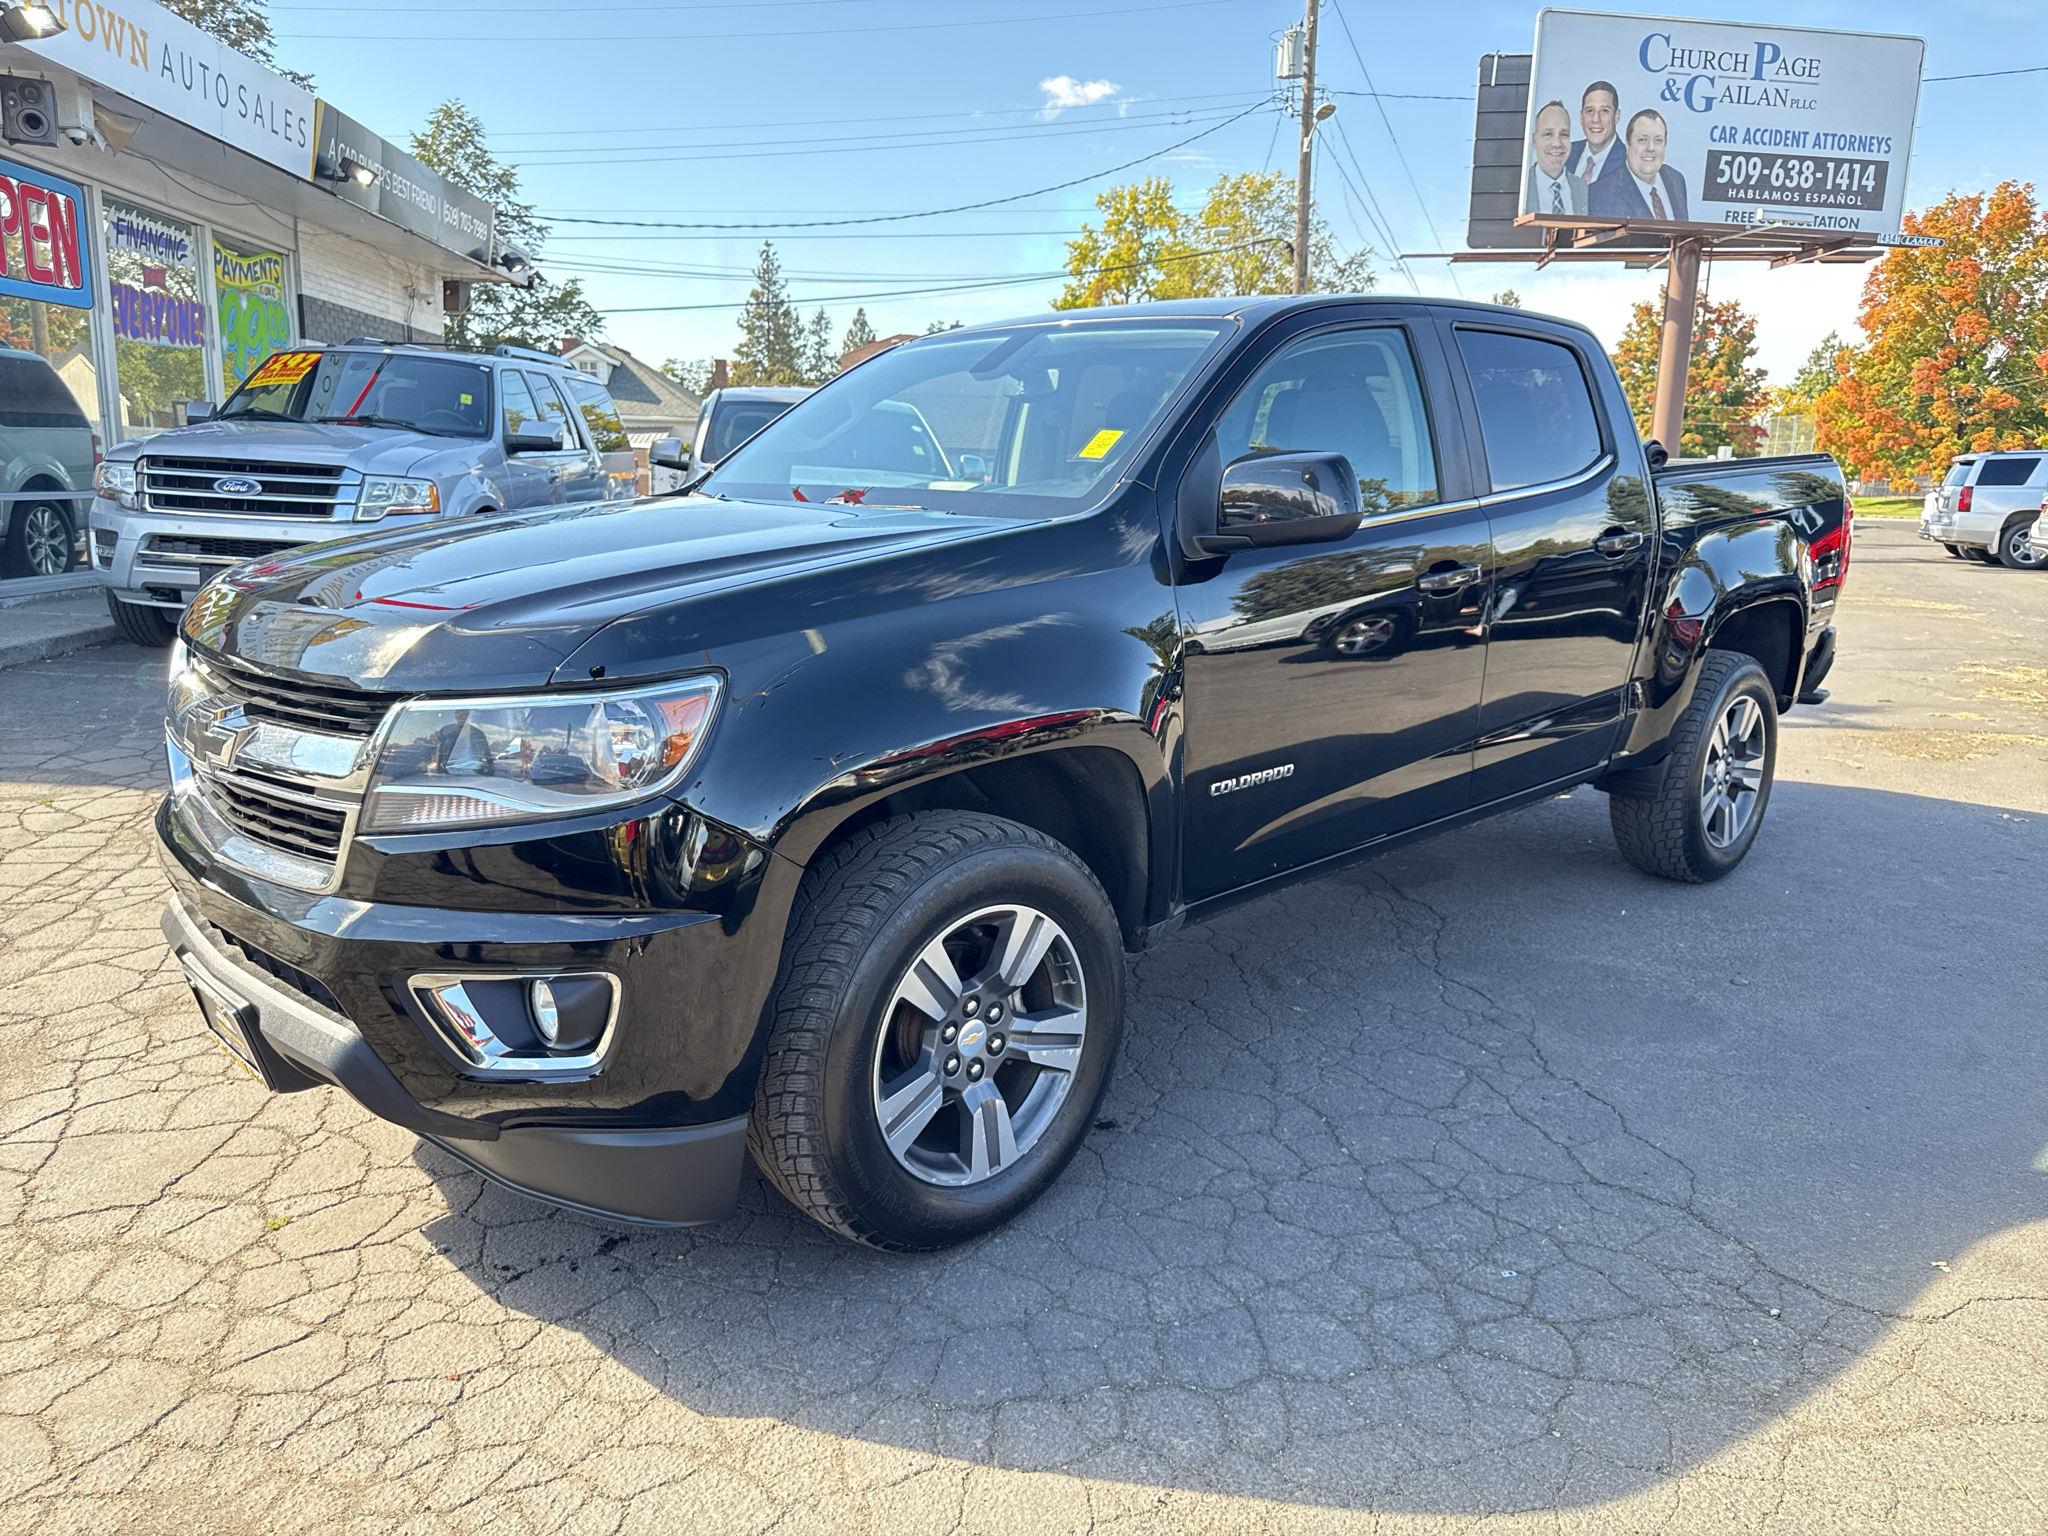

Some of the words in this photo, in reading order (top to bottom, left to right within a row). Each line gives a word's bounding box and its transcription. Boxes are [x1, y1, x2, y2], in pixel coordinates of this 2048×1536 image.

[1638, 32, 1750, 73] CHURCH
[1750, 41, 1821, 82] PAGE
[160, 43, 229, 109] AUTO
[238, 84, 306, 149] SALES
[1684, 74, 1790, 113] GAILAN
[1790, 98, 1817, 110] PLLC
[1709, 125, 1738, 145] CAR
[1742, 127, 1809, 149] ACCIDENT
[1812, 132, 1892, 154] ATTORNEYS
[328, 137, 336, 162] A
[392, 173, 412, 201] BEST
[411, 184, 436, 215] FRIEND
[1716, 155, 1876, 193] 509-638-1414
[1728, 188, 1800, 202] HABLAMOS
[1805, 190, 1863, 206] ESPAÑOL
[116, 216, 189, 262] FINANCING
[1725, 210, 1755, 224] FREE
[1757, 213, 1860, 230] TATION
[1905, 236, 1941, 247] LAMAR
[144, 269, 164, 284] FOR
[213, 246, 281, 284] PAYMENTS
[110, 280, 205, 347] EVERYONE!
[1208, 763, 1295, 797] COLORADO
